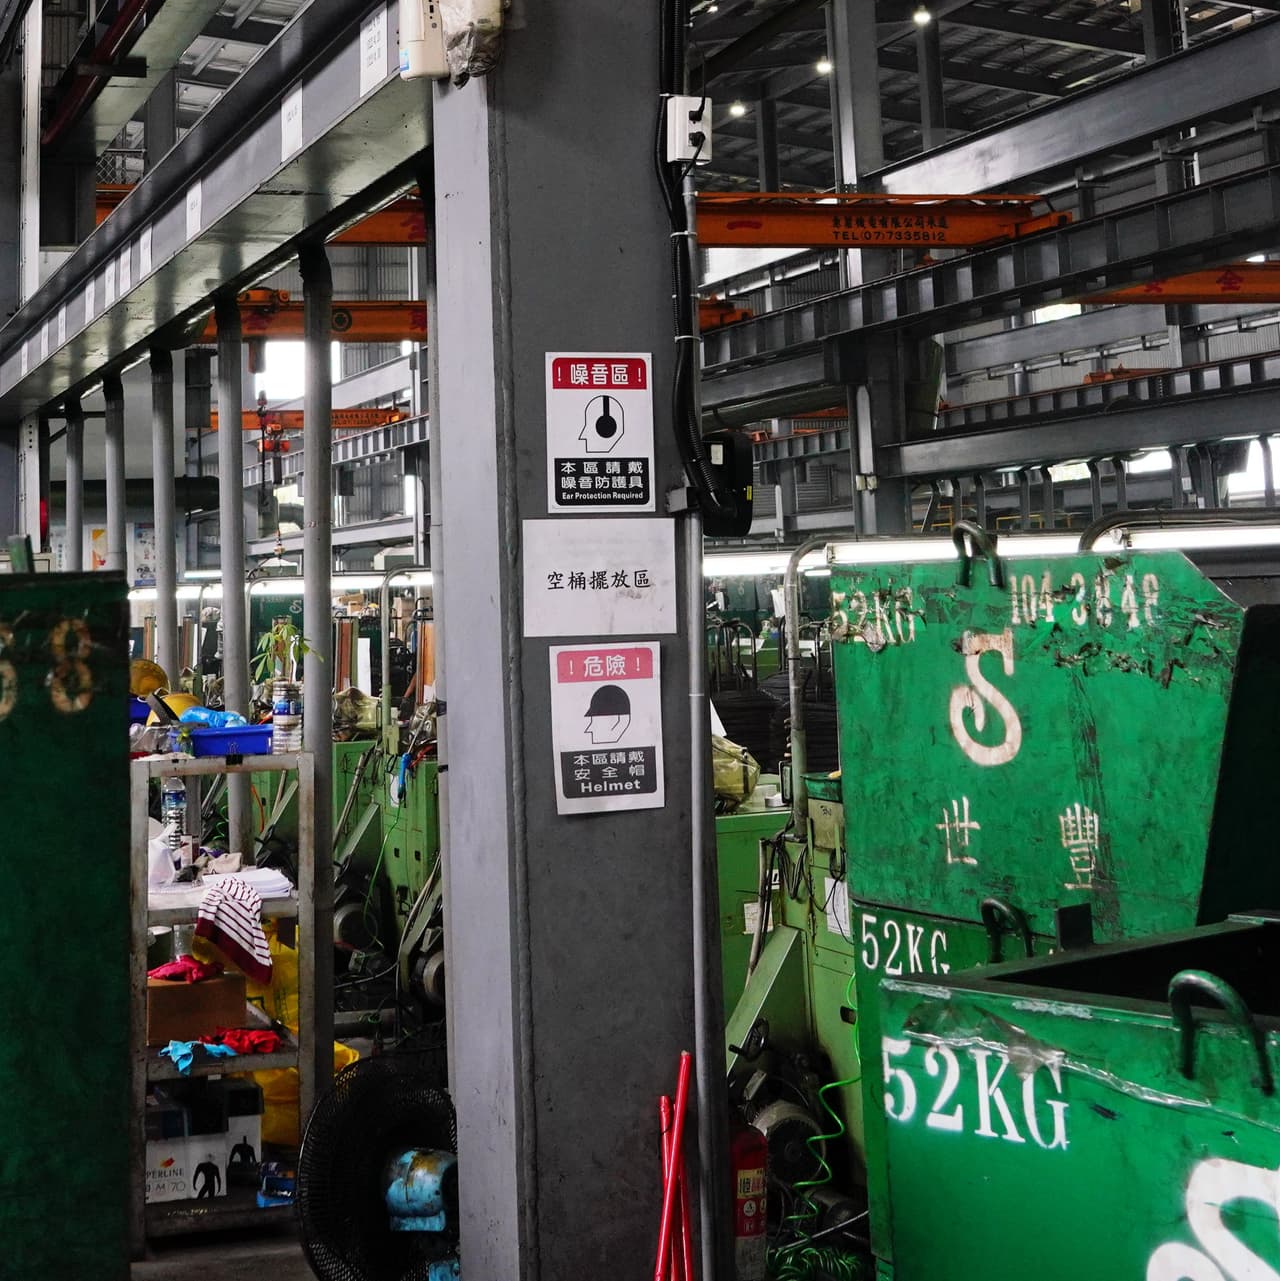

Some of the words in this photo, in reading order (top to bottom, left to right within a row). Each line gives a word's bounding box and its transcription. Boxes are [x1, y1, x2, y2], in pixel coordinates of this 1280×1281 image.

[570, 364, 629, 386] 噪音區
[561, 476, 644, 489] 噪音防護具
[562, 492, 574, 500] Ear
[575, 492, 612, 500] Protection
[613, 492, 644, 501] Required
[547, 570, 651, 590] 空桶擺放區
[584, 654, 627, 677] 危險
[573, 750, 645, 767] 本區請戴
[581, 778, 641, 793] Helmet
[861, 914, 950, 975] 52KG
[881, 1038, 1070, 1151] 52KG
